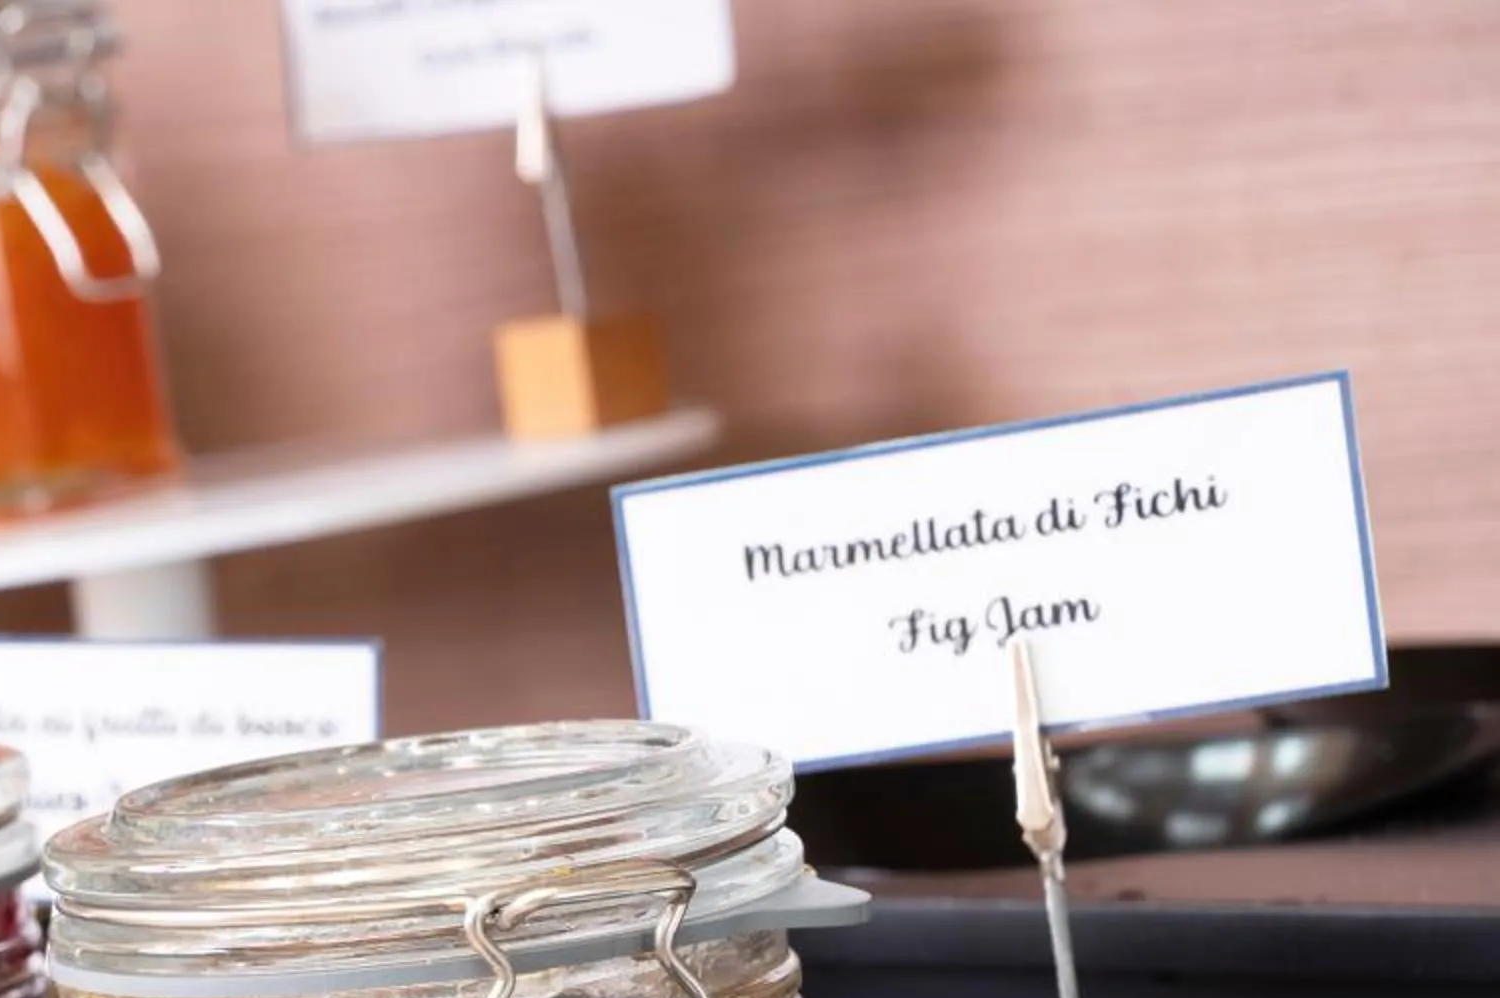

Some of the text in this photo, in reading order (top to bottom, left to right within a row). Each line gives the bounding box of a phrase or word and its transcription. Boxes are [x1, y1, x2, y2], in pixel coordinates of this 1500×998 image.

[743, 474, 1228, 582] Marmellata di Fichi
[887, 594, 1100, 656] Fig Jam
